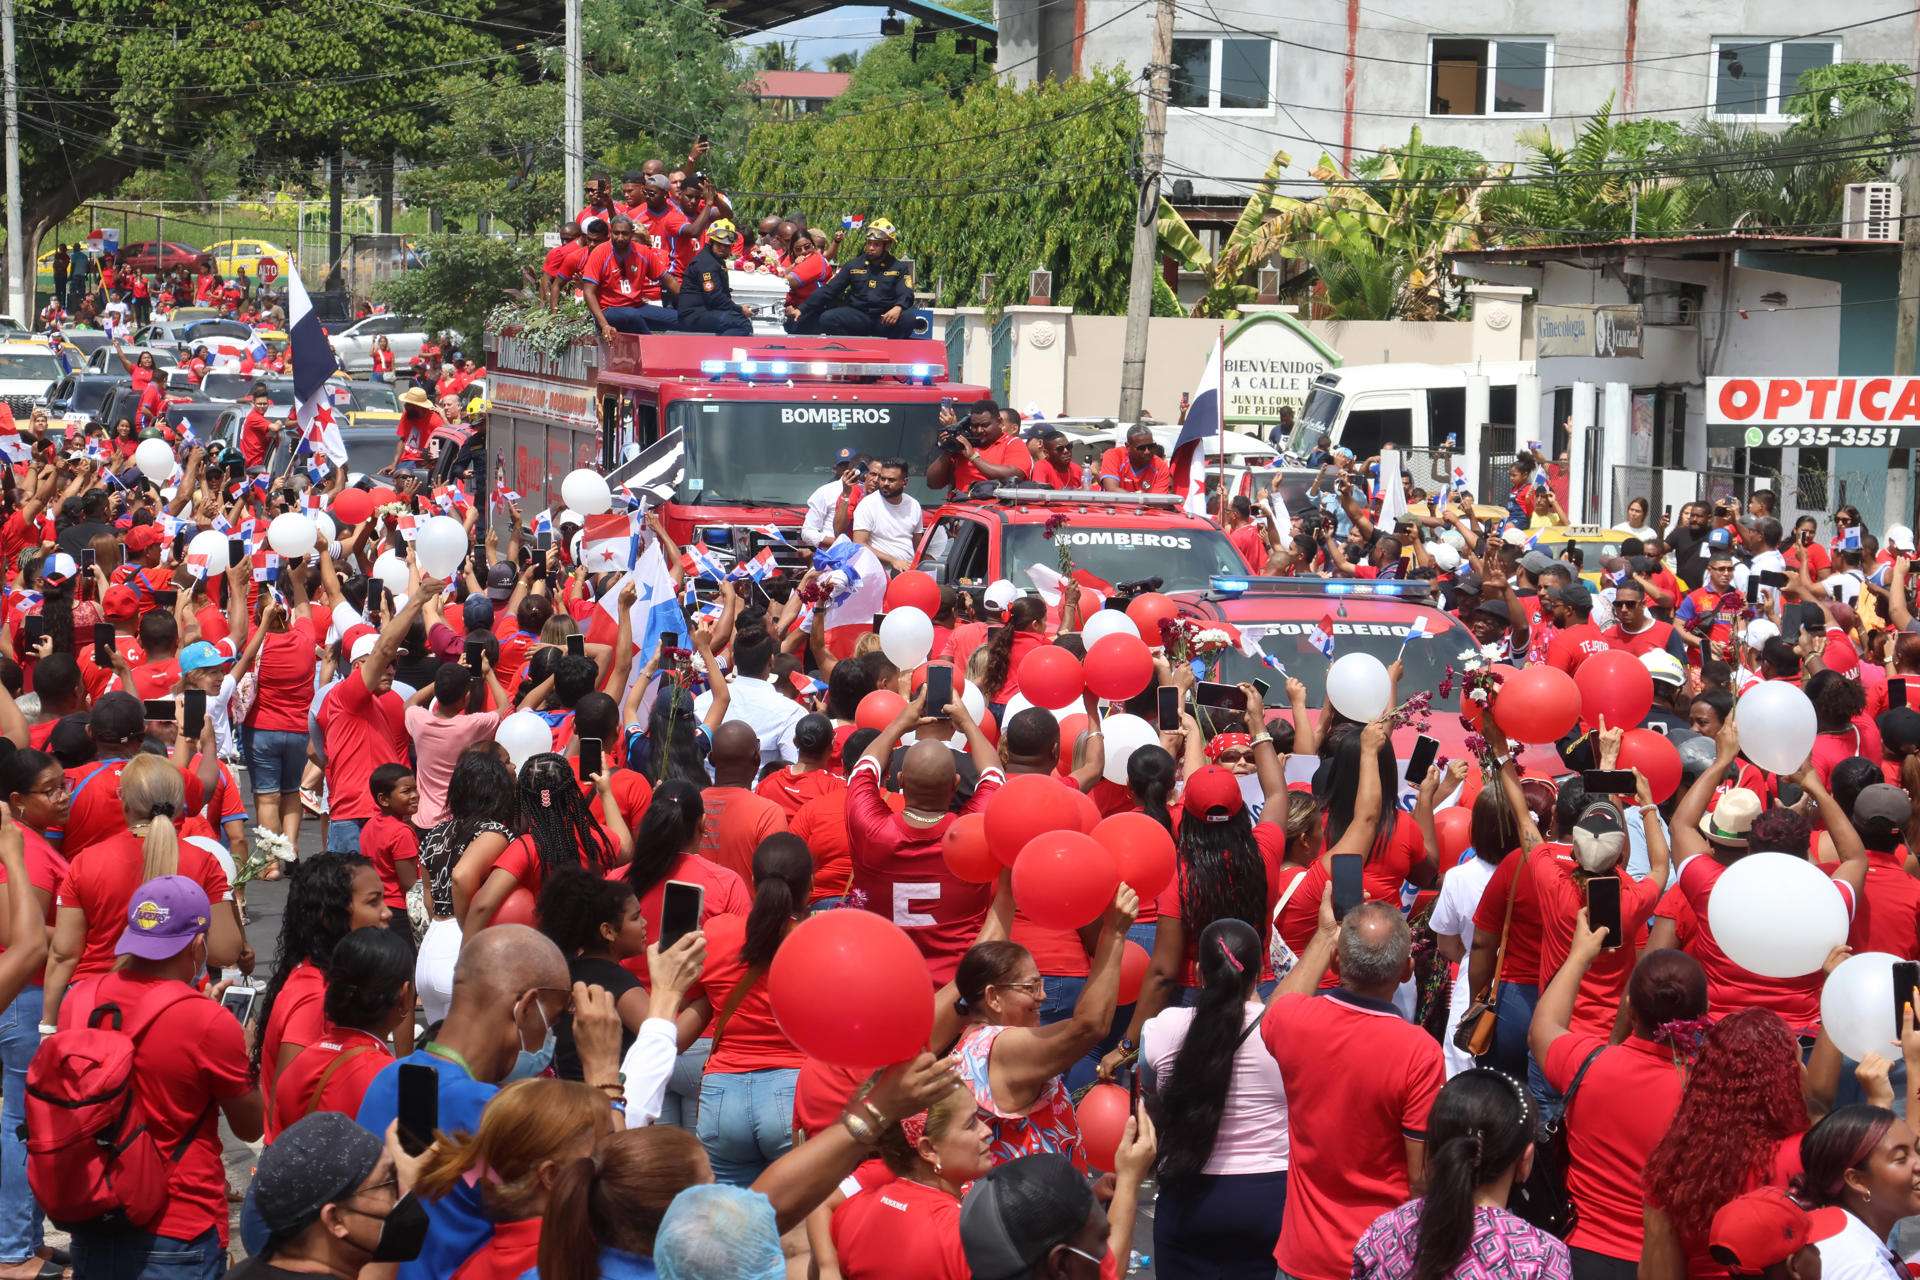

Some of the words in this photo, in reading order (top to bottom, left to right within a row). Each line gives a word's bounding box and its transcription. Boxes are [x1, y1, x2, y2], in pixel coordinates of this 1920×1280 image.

[619, 279, 632, 295] 18
[1224, 358, 1323, 375] BIENVENIDOS
[1231, 376, 1241, 389] A
[1249, 376, 1300, 390] CALLE
[1231, 395, 1265, 405] JUNTA
[781, 408, 891, 424] BOMBEROS
[1237, 405, 1250, 415] DE
[1767, 427, 1900, 447] 6935-3551
[1264, 623, 1434, 638] BOMBERO
